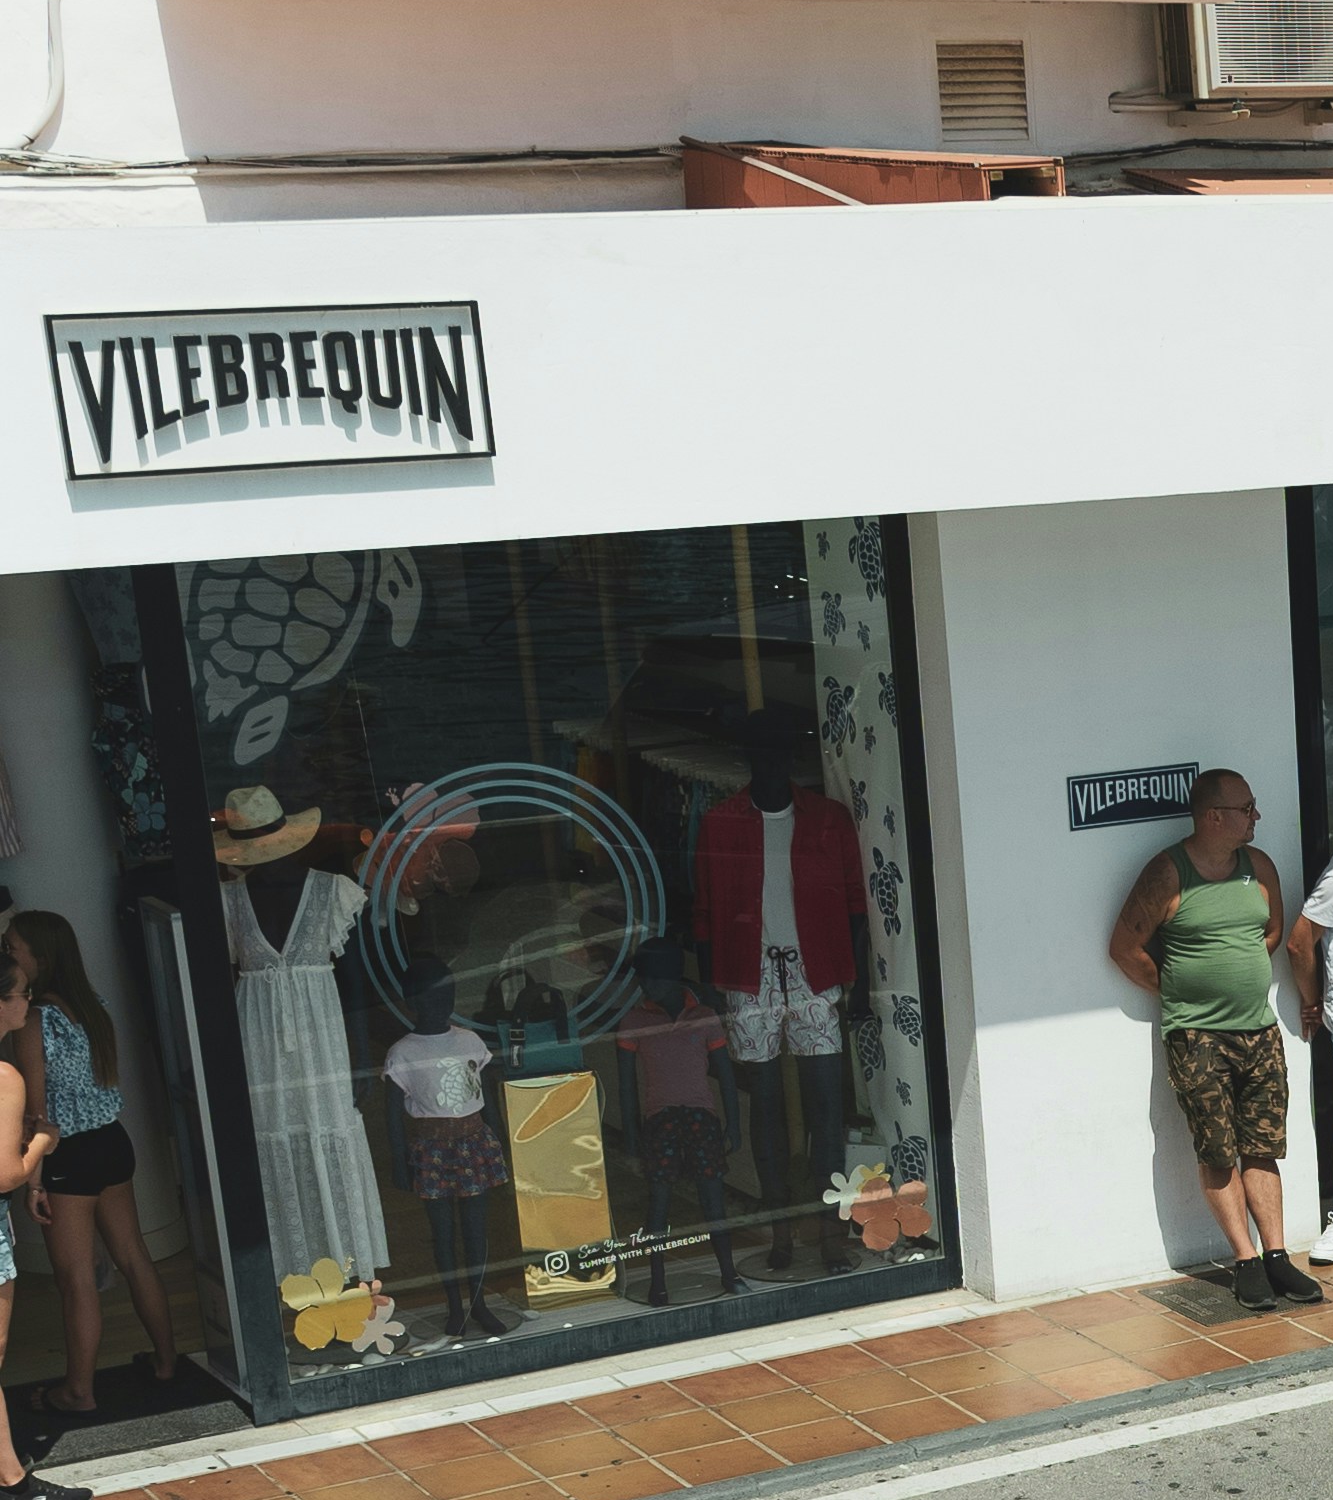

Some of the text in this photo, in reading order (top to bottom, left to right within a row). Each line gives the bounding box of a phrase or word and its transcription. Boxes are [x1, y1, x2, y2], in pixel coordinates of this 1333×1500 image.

[68, 325, 474, 464] VILEBREQUIN
[1075, 772, 1193, 823] VILEBREQUIN
[579, 1233, 711, 1270] SUMMER WITH @VILEBREQUIN
